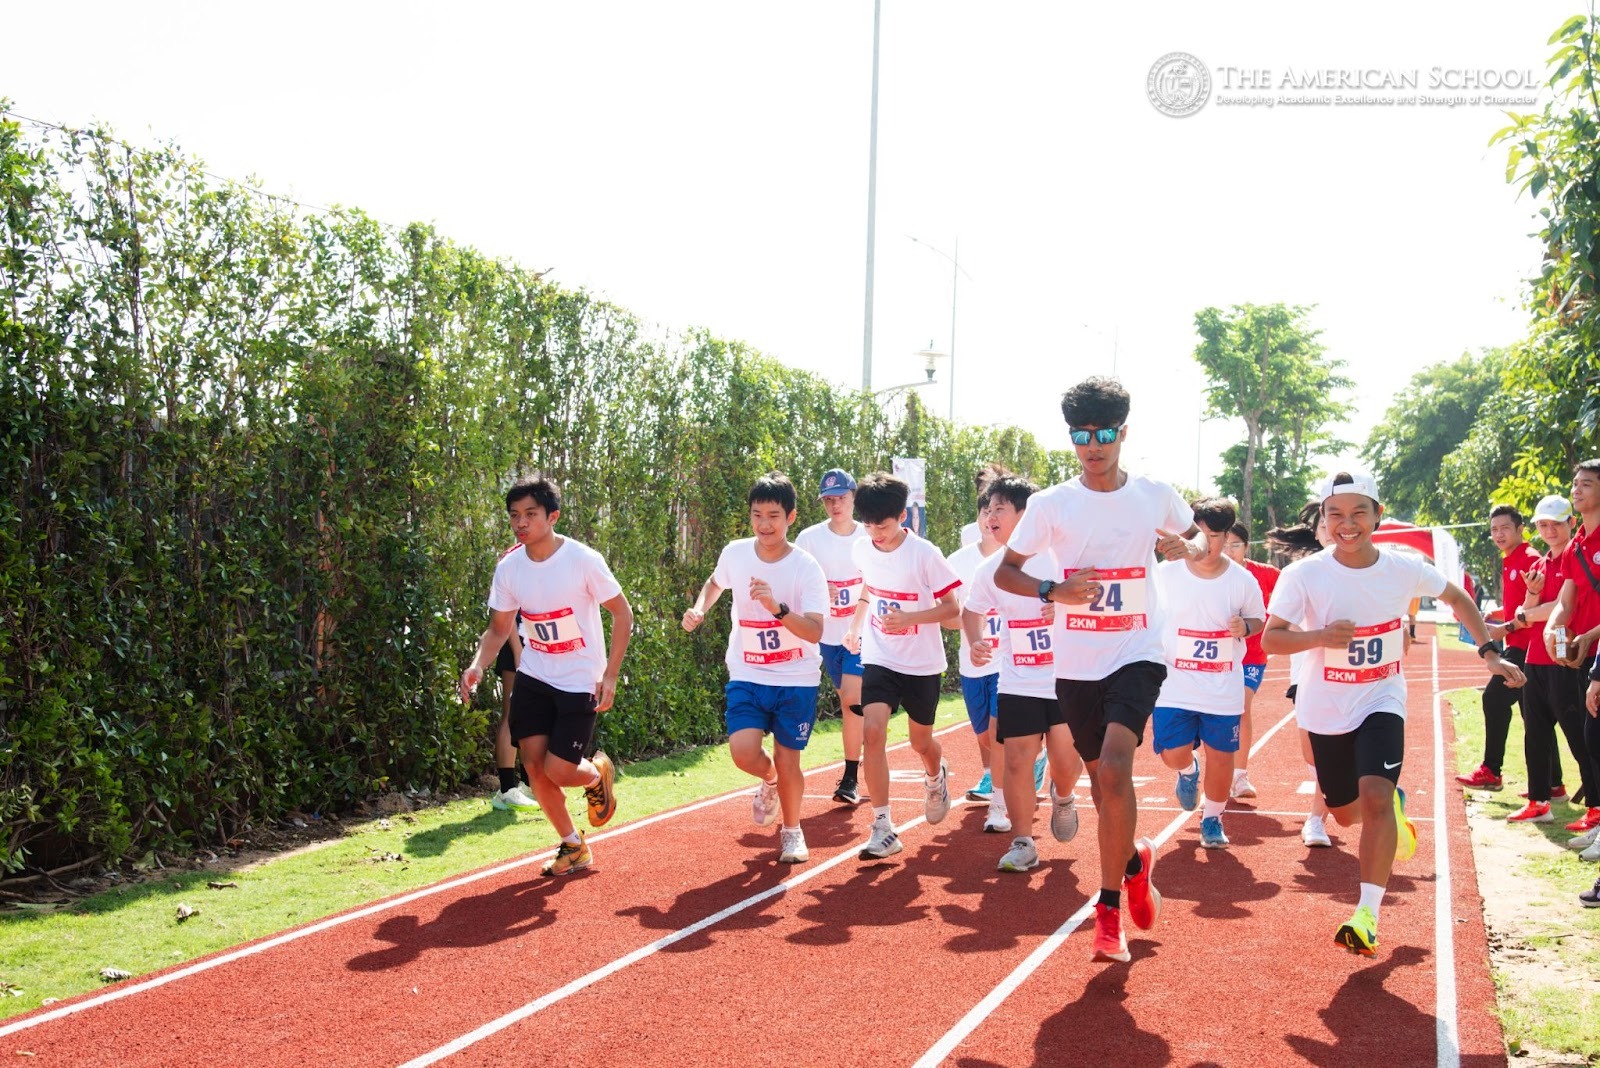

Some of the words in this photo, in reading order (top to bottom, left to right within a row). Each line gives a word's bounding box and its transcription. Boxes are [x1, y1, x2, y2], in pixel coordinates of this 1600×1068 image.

[1089, 583, 1123, 612] 24
[1069, 617, 1097, 629] 2KM
[534, 621, 559, 642] 07
[1026, 628, 1051, 651] 15
[531, 641, 549, 652] 2KM
[756, 630, 781, 650] 13
[1192, 640, 1218, 660] 25
[1348, 637, 1383, 666] 59
[745, 654, 766, 663] 2KM
[1015, 656, 1036, 665] 2KM
[1176, 660, 1198, 670] 2KM
[1327, 670, 1357, 682] 2KM
